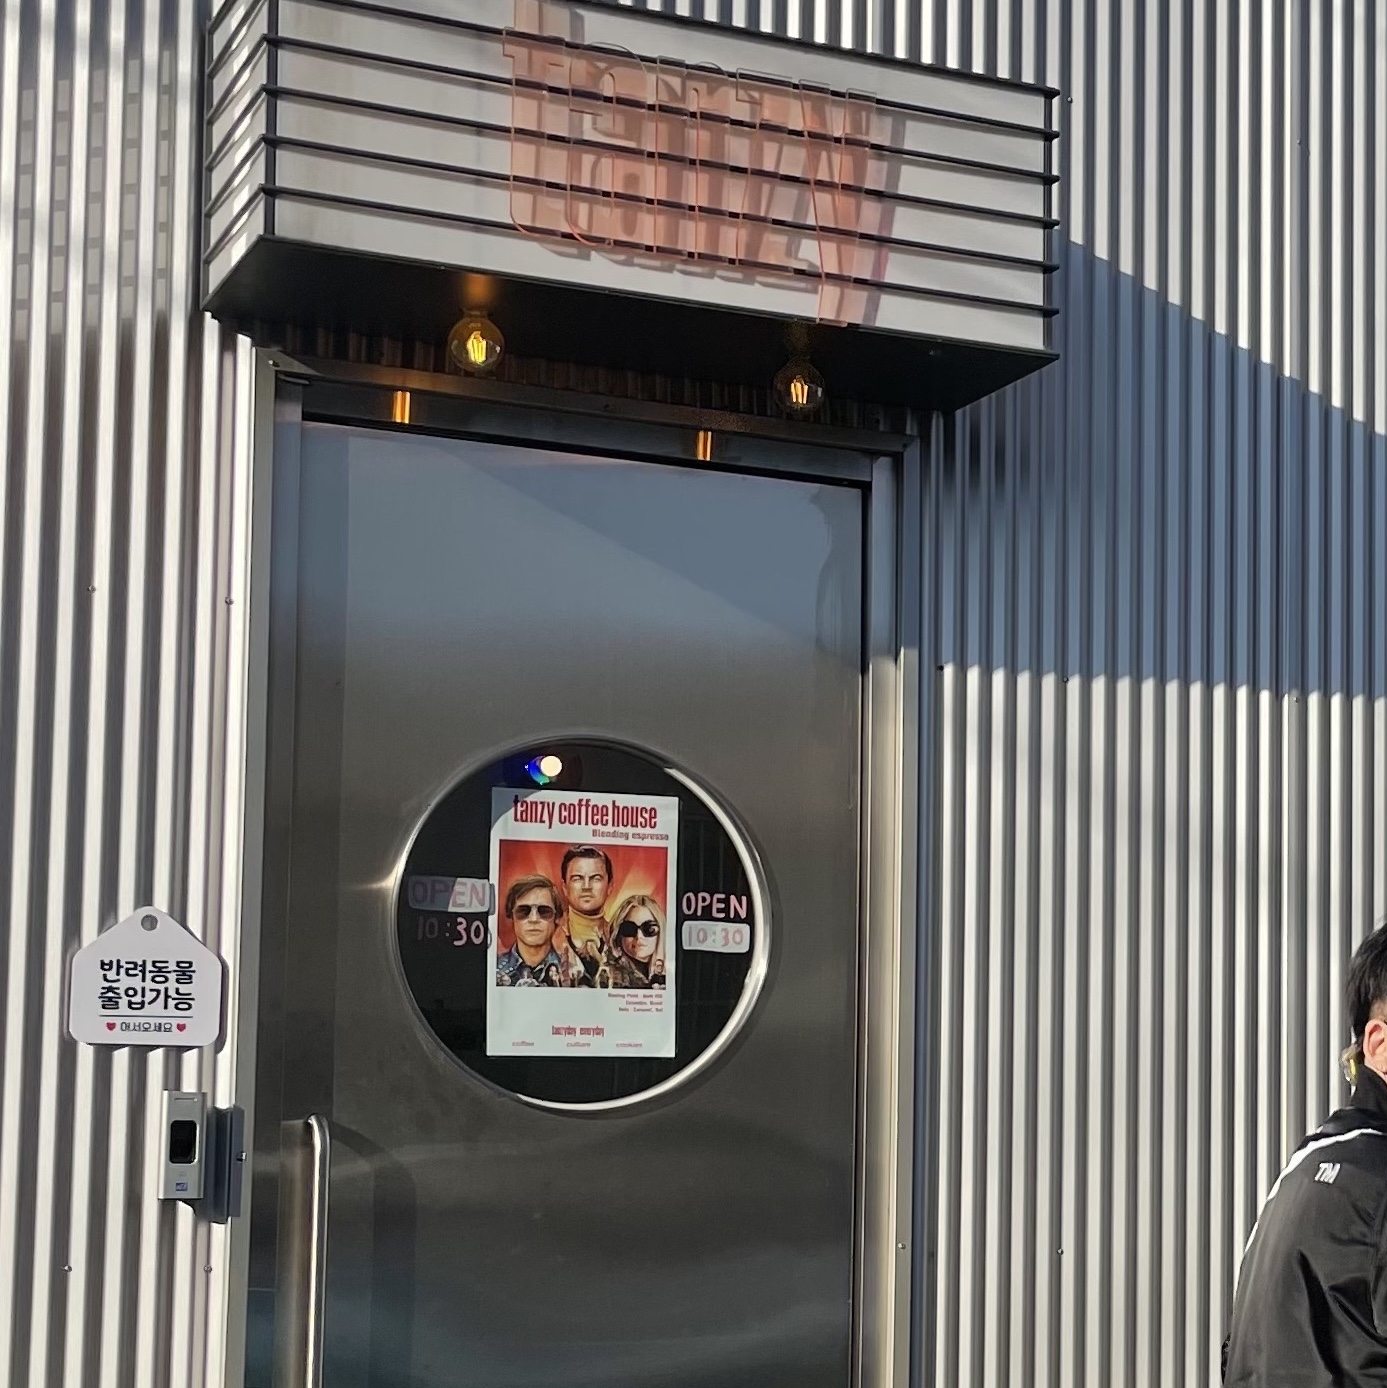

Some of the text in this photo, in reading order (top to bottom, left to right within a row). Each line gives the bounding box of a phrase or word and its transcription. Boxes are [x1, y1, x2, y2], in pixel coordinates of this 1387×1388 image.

[513, 794, 657, 829] tanzy coffee house
[592, 829, 629, 840] Blending
[413, 880, 487, 908] OPEN
[682, 892, 748, 919] OPEN
[688, 926, 744, 947] 10:30
[98, 959, 196, 985] 반려동물
[98, 985, 195, 1011] 출입가능
[120, 1022, 173, 1033] 어서오세요
[1314, 1162, 1341, 1184] TM
